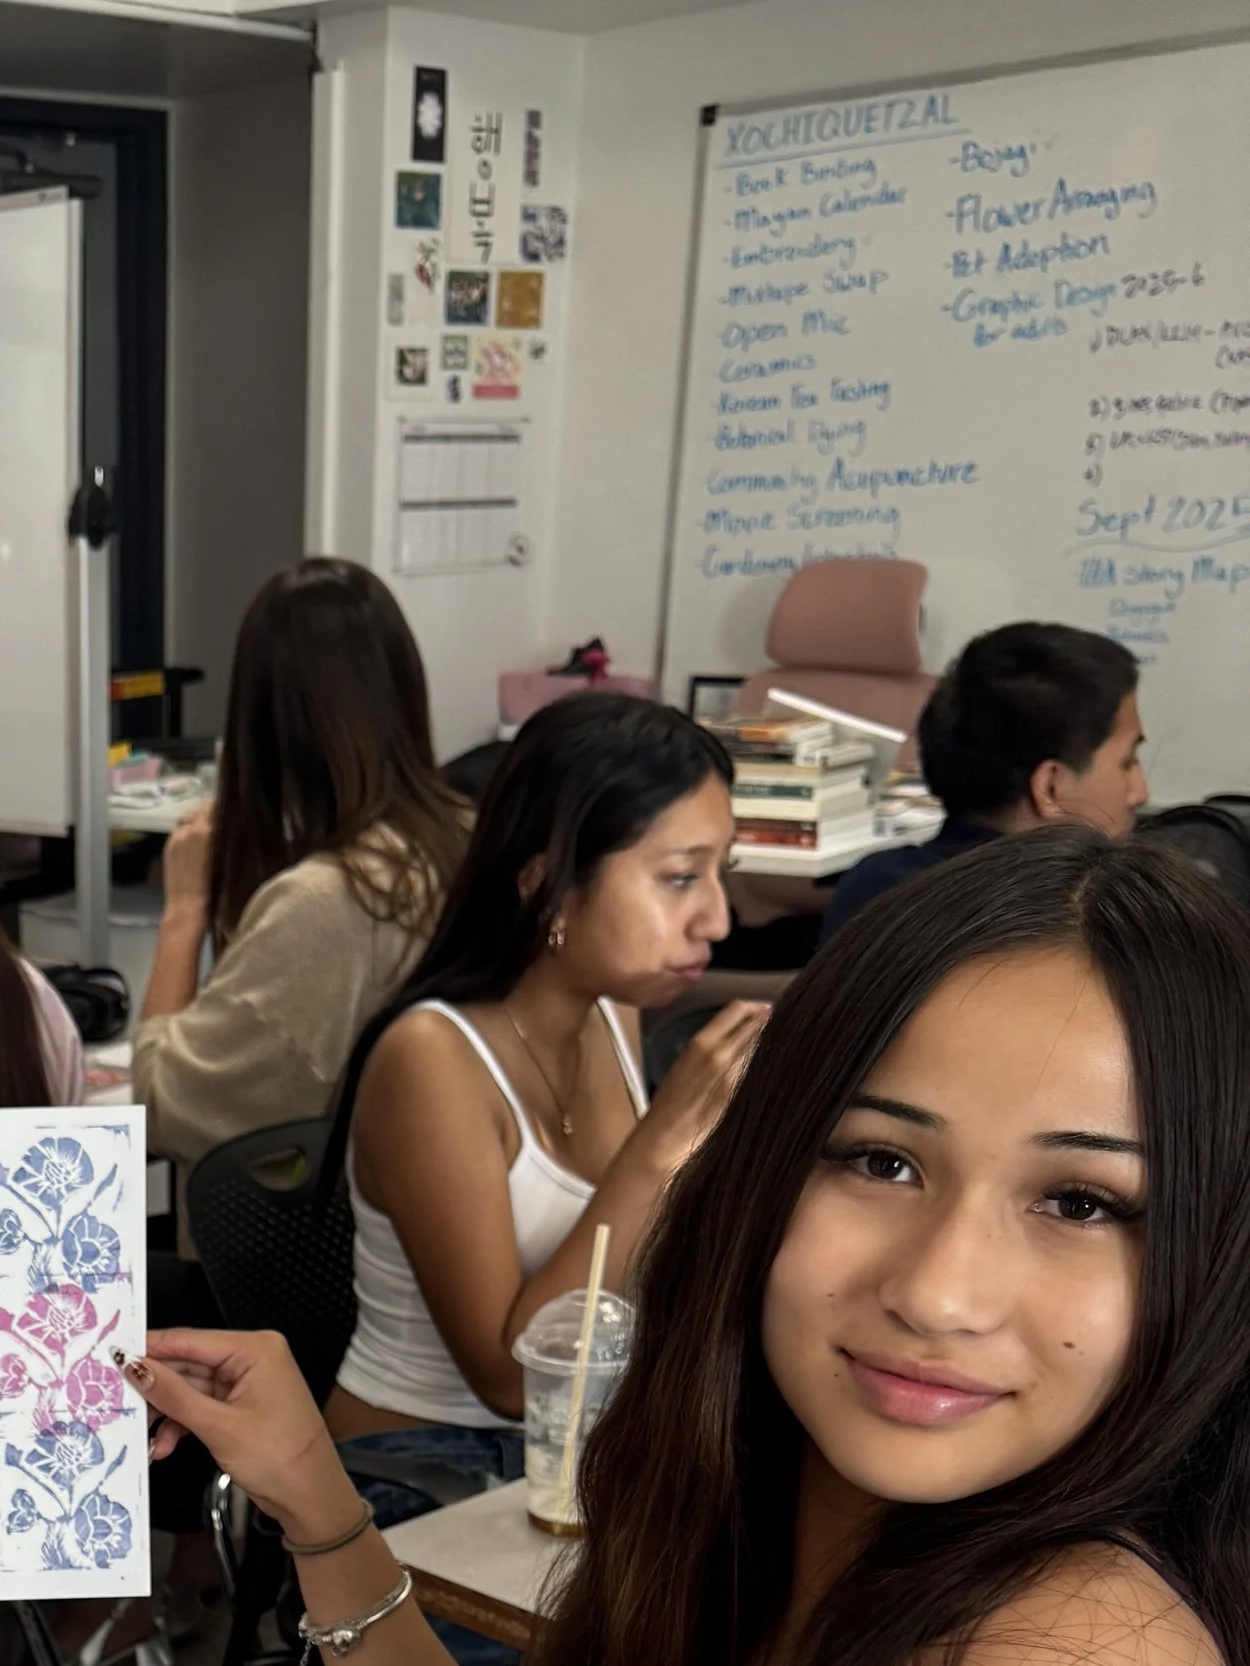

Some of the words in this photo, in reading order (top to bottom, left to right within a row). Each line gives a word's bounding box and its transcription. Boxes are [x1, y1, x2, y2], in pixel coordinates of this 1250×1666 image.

[955, 192, 1046, 235] Flower
[996, 230, 1111, 274] Adoption
[720, 321, 788, 352] Open
[825, 456, 980, 500] Acupuncture
